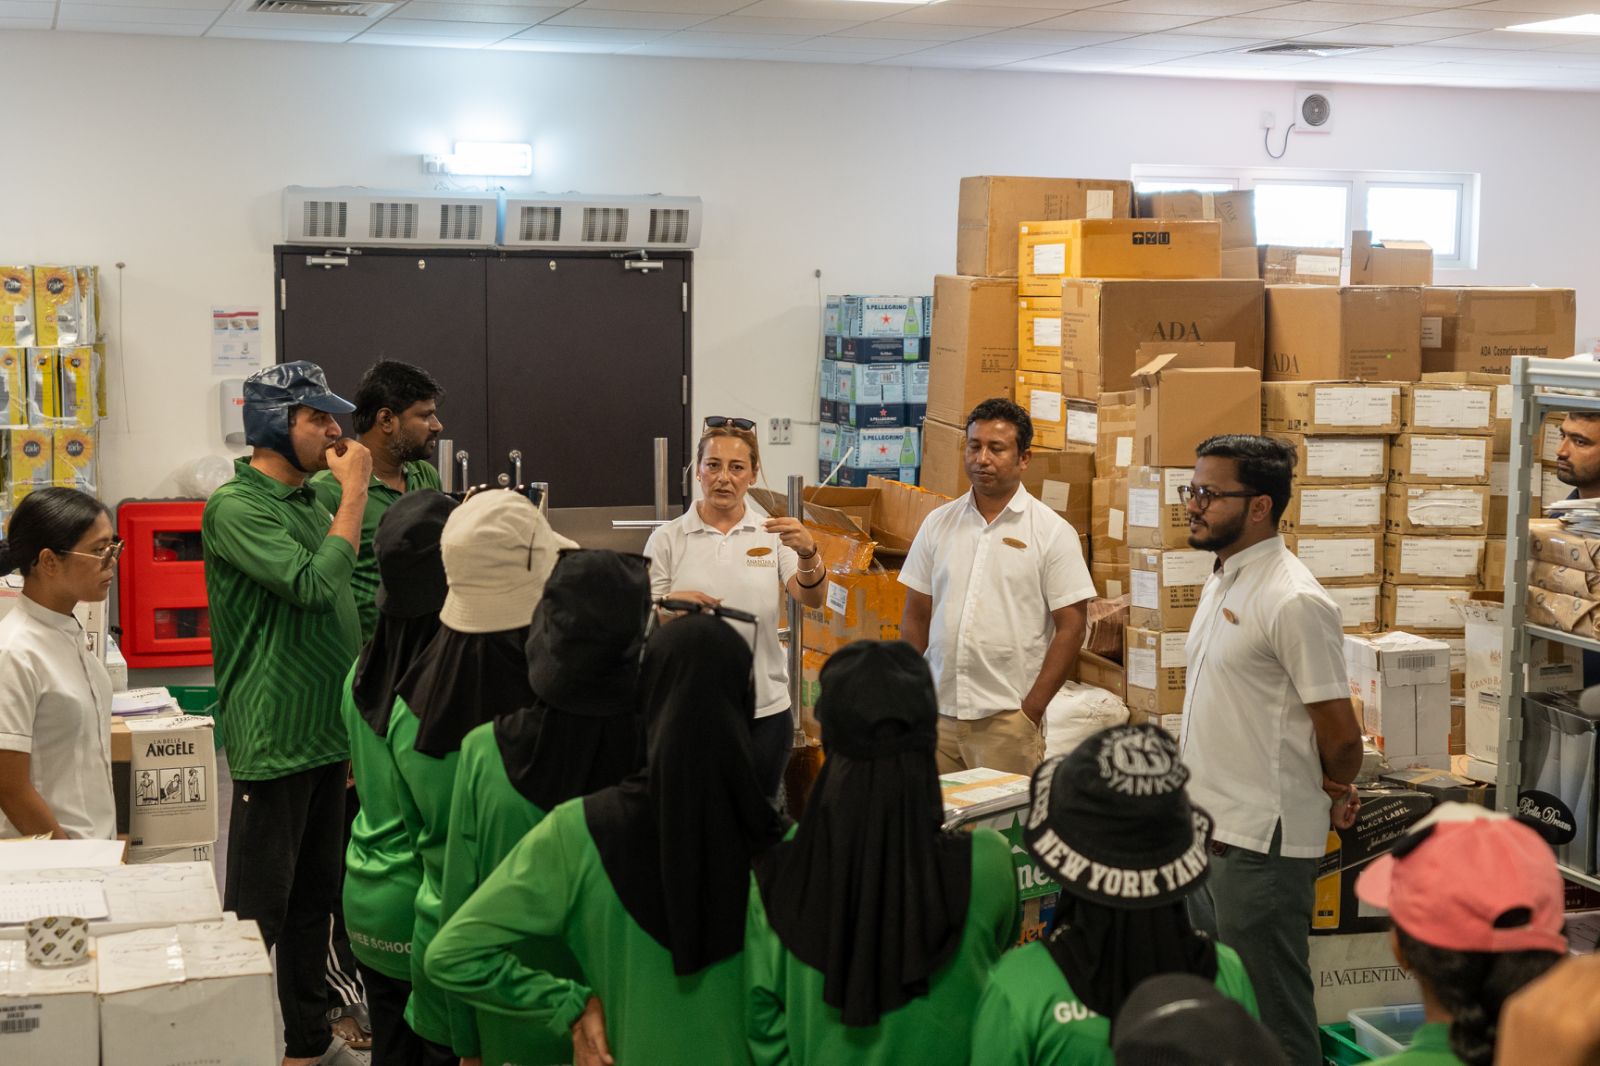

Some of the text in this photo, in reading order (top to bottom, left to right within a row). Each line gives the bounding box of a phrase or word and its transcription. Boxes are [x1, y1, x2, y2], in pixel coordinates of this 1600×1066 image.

[1151, 320, 1202, 341] ADA
[1480, 345, 1492, 356] ADA
[1494, 345, 1518, 356] Cosmetics
[1272, 352, 1300, 374] ADA
[1356, 806, 1411, 832] BLACK LABEL
[1519, 796, 1572, 832] Bella Dream
[1032, 828, 1091, 882] NEW
[1086, 861, 1160, 898] YORK
[1320, 970, 1334, 987] LA
